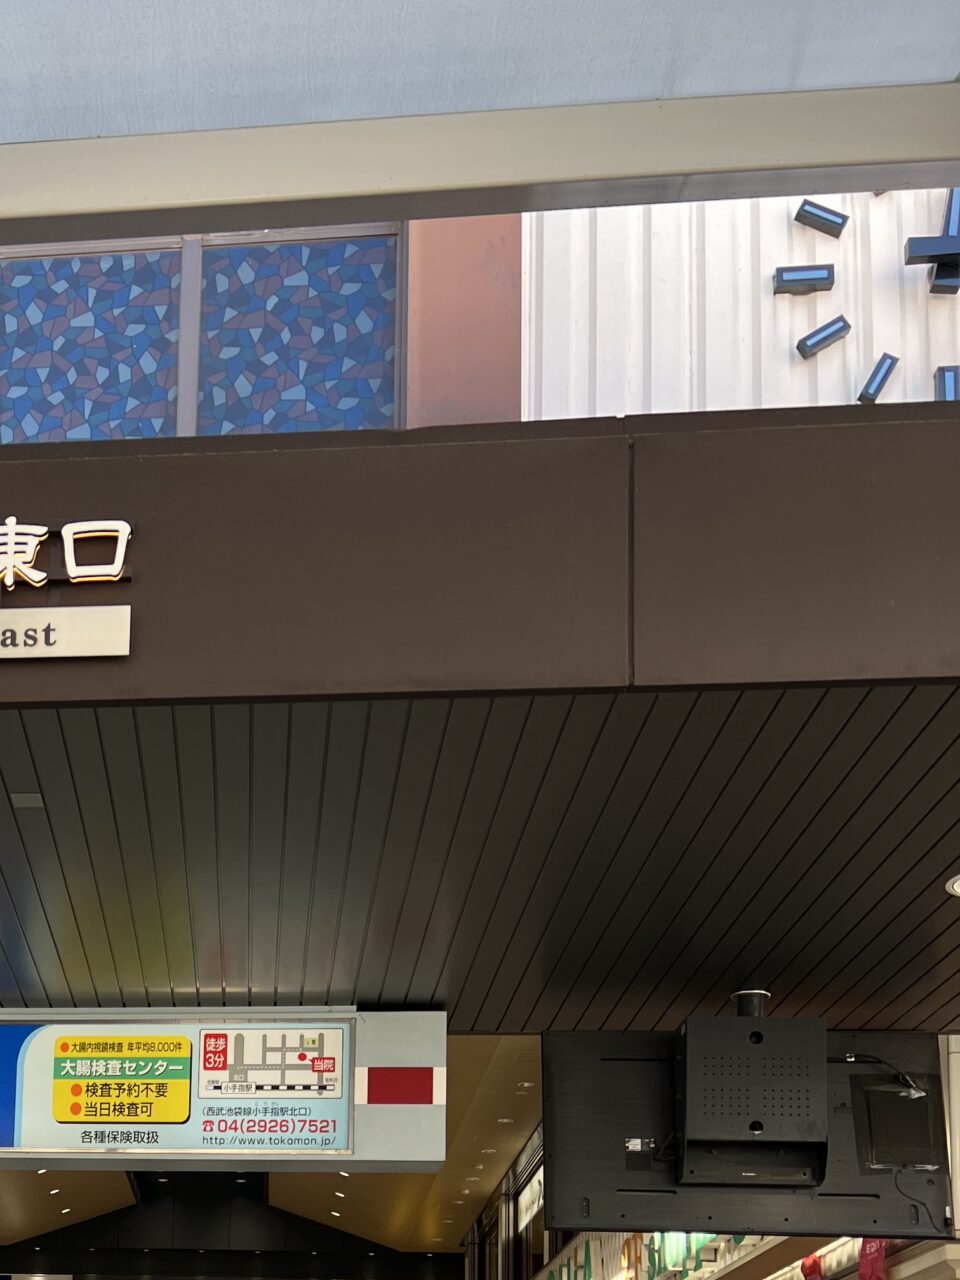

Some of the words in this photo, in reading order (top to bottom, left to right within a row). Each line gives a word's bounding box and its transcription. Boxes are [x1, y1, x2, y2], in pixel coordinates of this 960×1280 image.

[205, 1037, 226, 1052] 徒歩
[60, 1059, 184, 1077] 大腸検査センター
[205, 1053, 225, 1068] 3分
[313, 1059, 335, 1071] 当院
[85, 1082, 169, 1098] 検査予約不要
[84, 1101, 154, 1118] 当日検査可
[217, 1119, 337, 1134] 04(2926)7521
[81, 1130, 159, 1144] 各種保険取扱
[202, 1136, 337, 1147] http://www.tokomon.jp/
